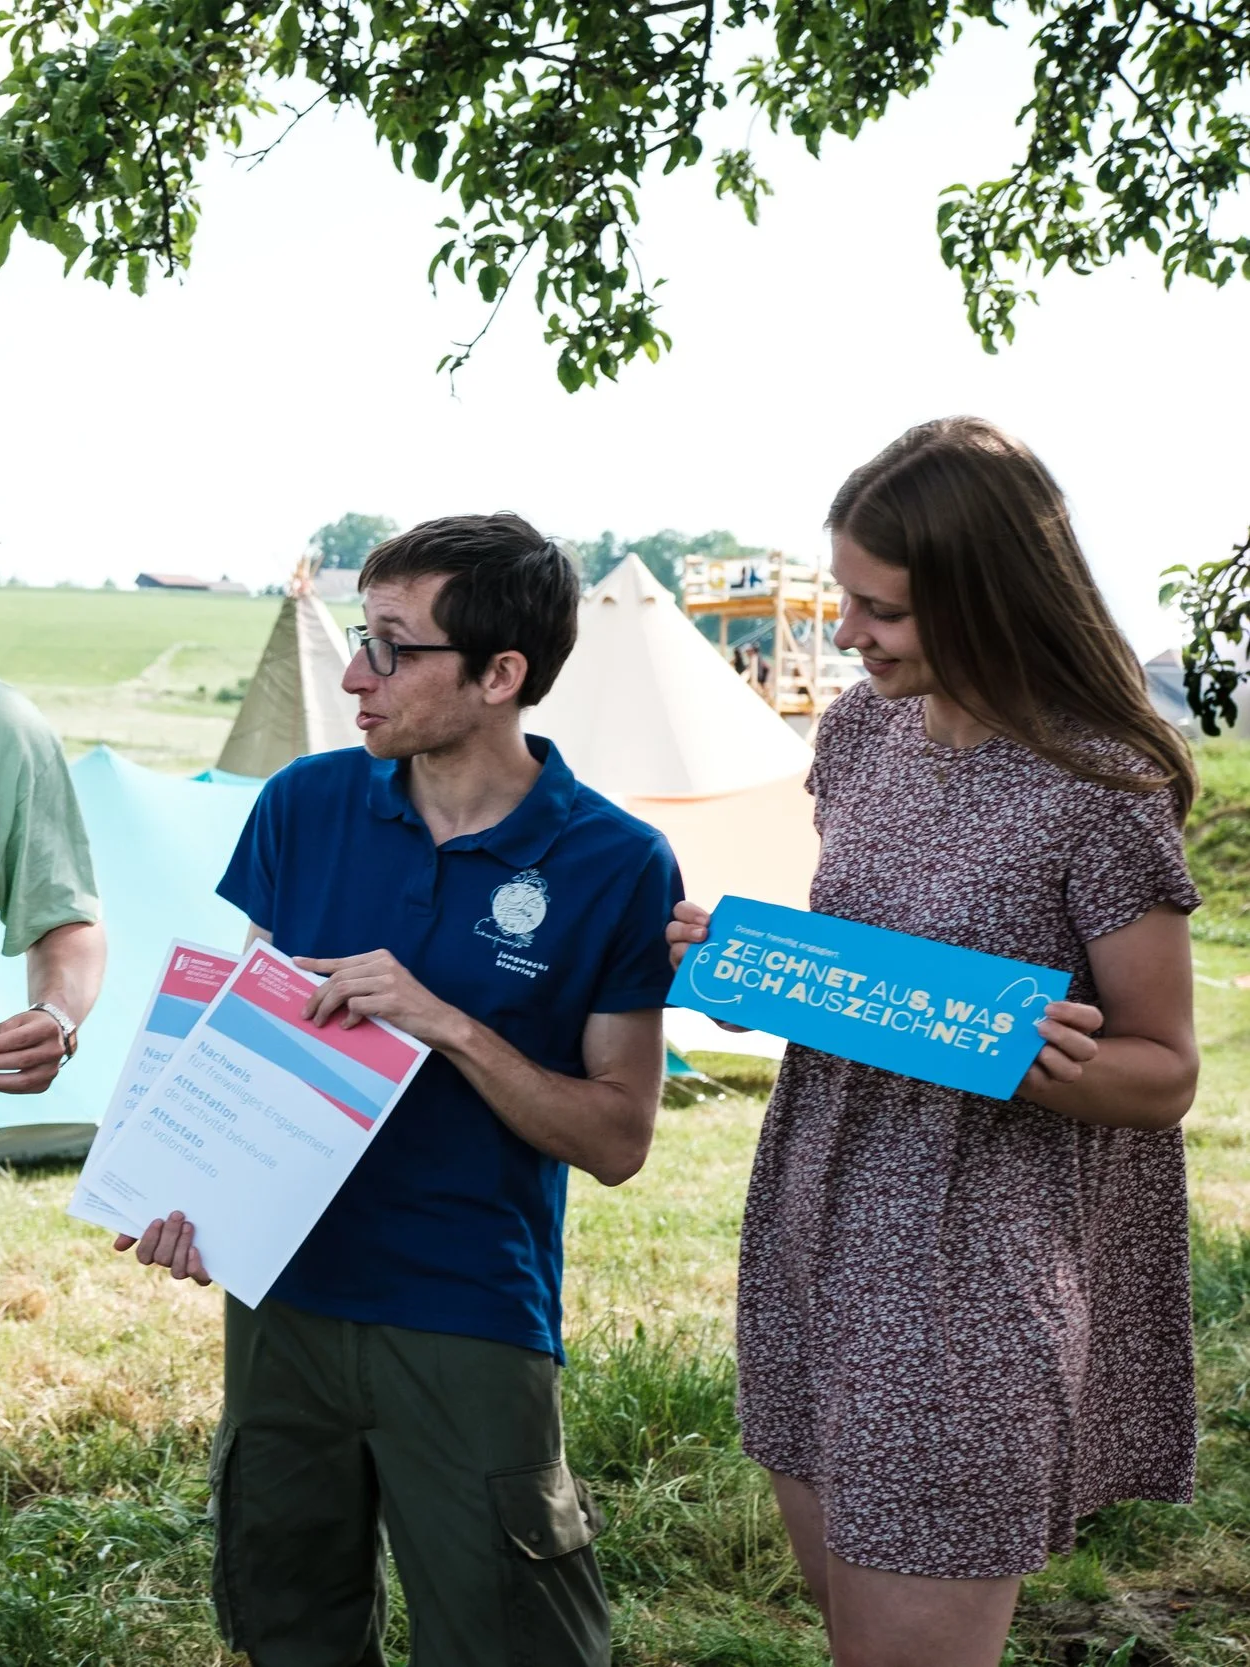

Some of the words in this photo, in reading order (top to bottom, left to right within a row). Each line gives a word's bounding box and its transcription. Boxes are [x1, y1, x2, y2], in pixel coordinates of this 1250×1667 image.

[713, 959, 784, 1001] DICH
[785, 980, 1000, 1056] AUSZEICHNET.
[721, 938, 867, 993] ZEICHNET
[868, 980, 934, 1019] AUS,
[944, 997, 1014, 1035] WAS
[197, 1041, 252, 1083] Nachweis
[173, 1074, 238, 1124] Attestation
[150, 1107, 204, 1148] Attestato
[154, 1129, 219, 1178] volontariato
[164, 1087, 179, 1102] de
[226, 1128, 278, 1170] bénévole
[264, 1105, 335, 1159] Engagement
